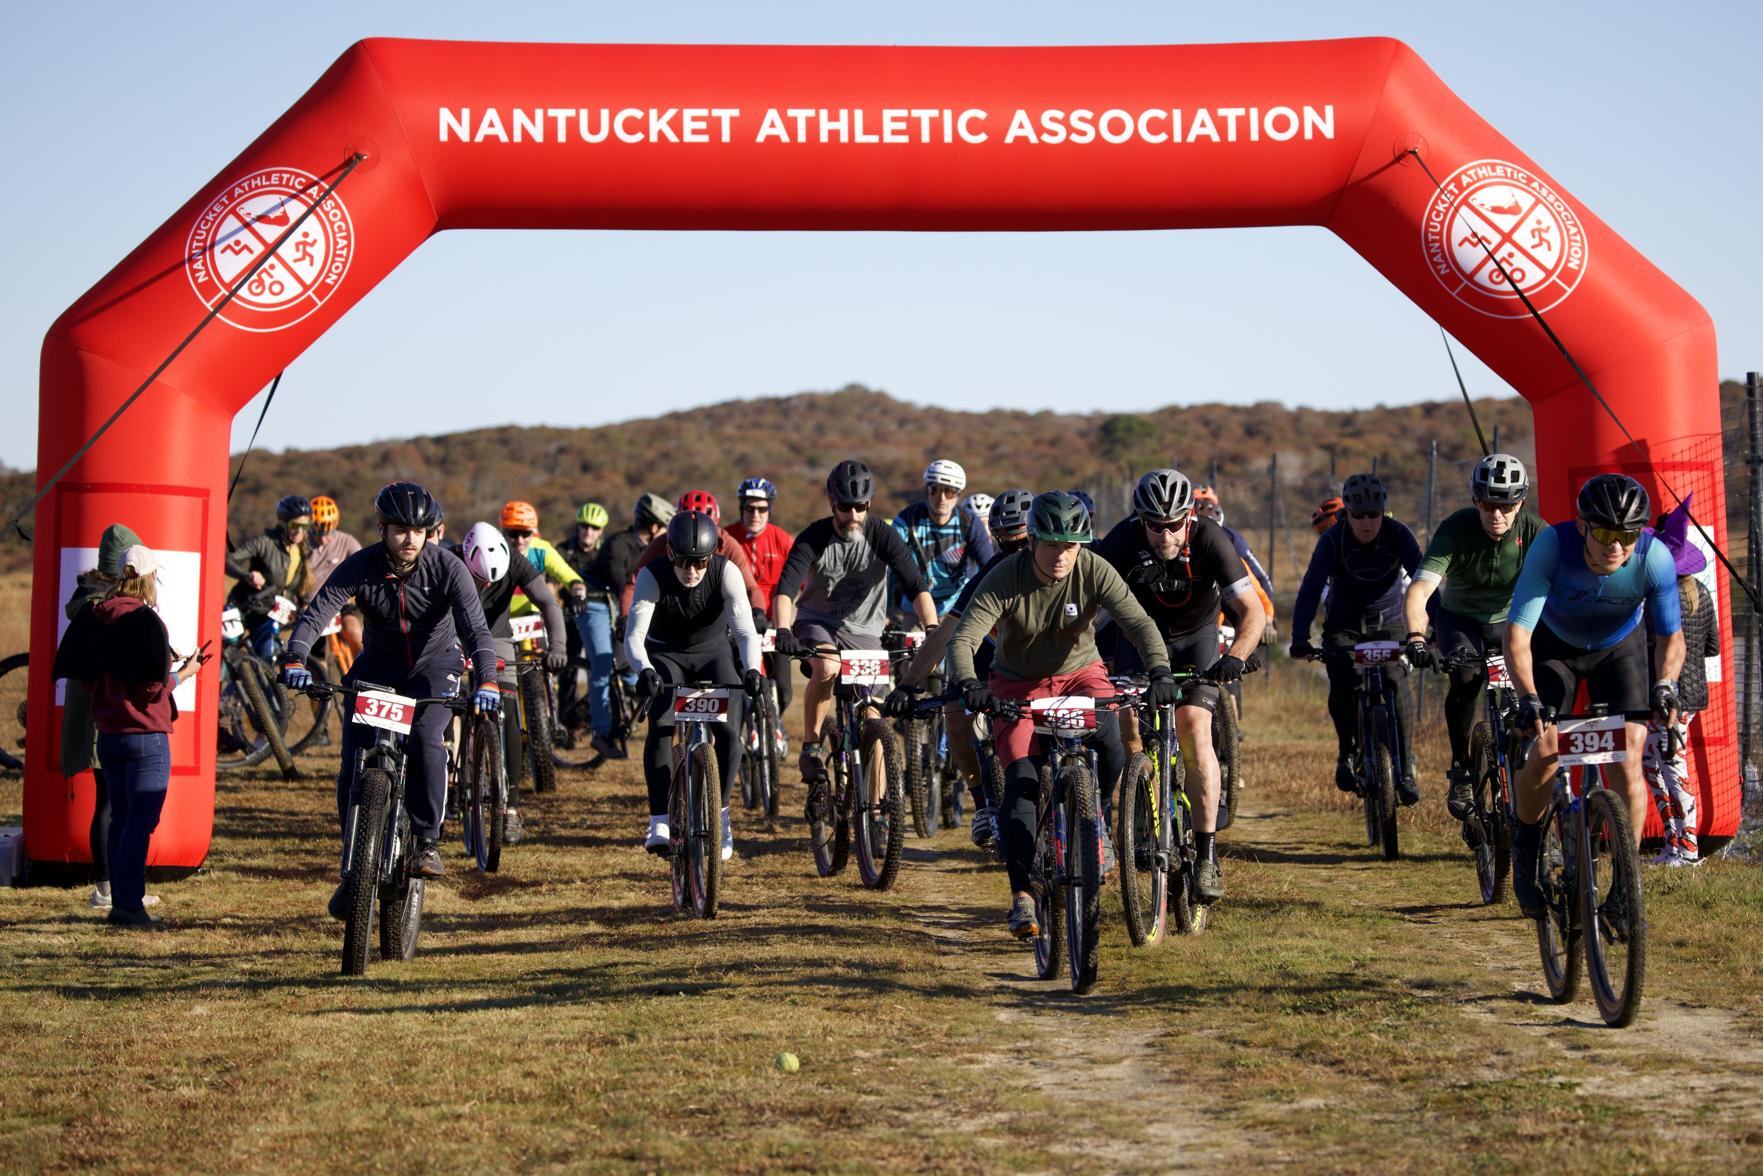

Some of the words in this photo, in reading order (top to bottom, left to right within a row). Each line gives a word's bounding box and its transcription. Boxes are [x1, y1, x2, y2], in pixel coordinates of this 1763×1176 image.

[438, 107, 740, 144] NANTUCKET
[755, 107, 989, 144] ATHLETIC
[1003, 104, 1335, 145] ASSOCIATION
[191, 195, 230, 284] NANTUCKET
[233, 173, 306, 199] ATHLETIC
[1428, 182, 1460, 276] NANTUCKET
[1460, 165, 1528, 188] ATHLETIC
[1530, 180, 1583, 271] ASSOCIATION
[364, 698, 404, 722] 375
[684, 698, 720, 713] 390
[1569, 730, 1616, 754] 394
